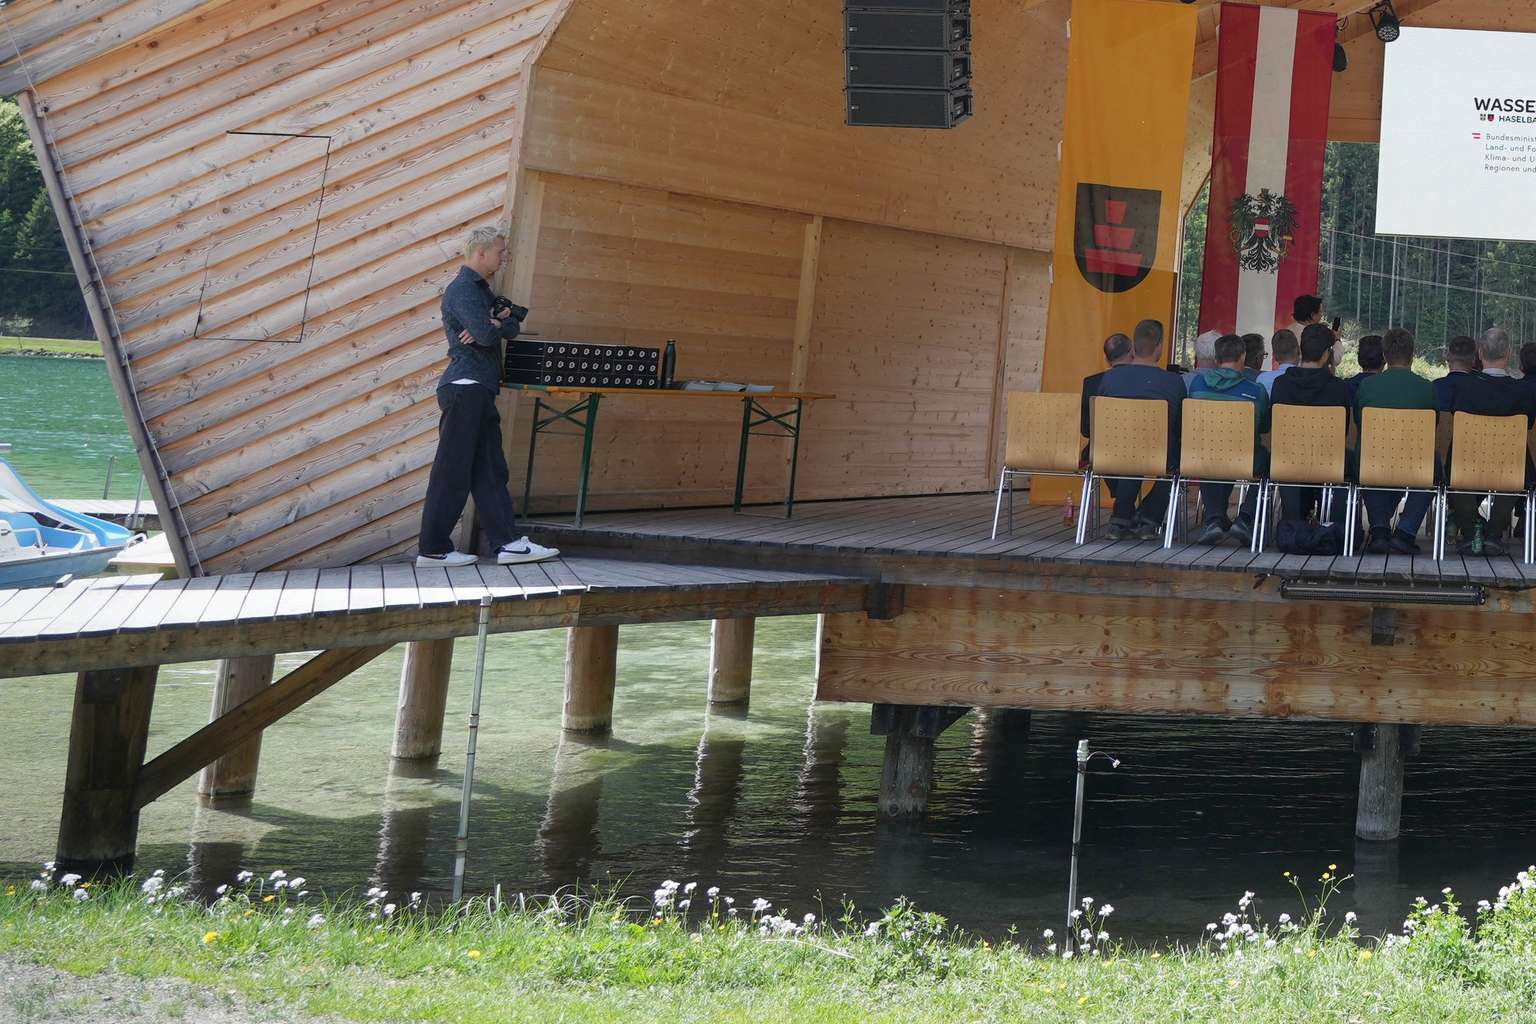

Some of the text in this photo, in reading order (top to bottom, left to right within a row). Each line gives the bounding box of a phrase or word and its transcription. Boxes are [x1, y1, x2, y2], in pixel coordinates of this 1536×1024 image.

[1485, 143, 1507, 152] Land-
[1509, 144, 1525, 152] und
[1484, 154, 1510, 163] Klima-
[1512, 155, 1527, 163] und
[1484, 164, 1520, 174] Regionen
[1522, 165, 1536, 173] und
